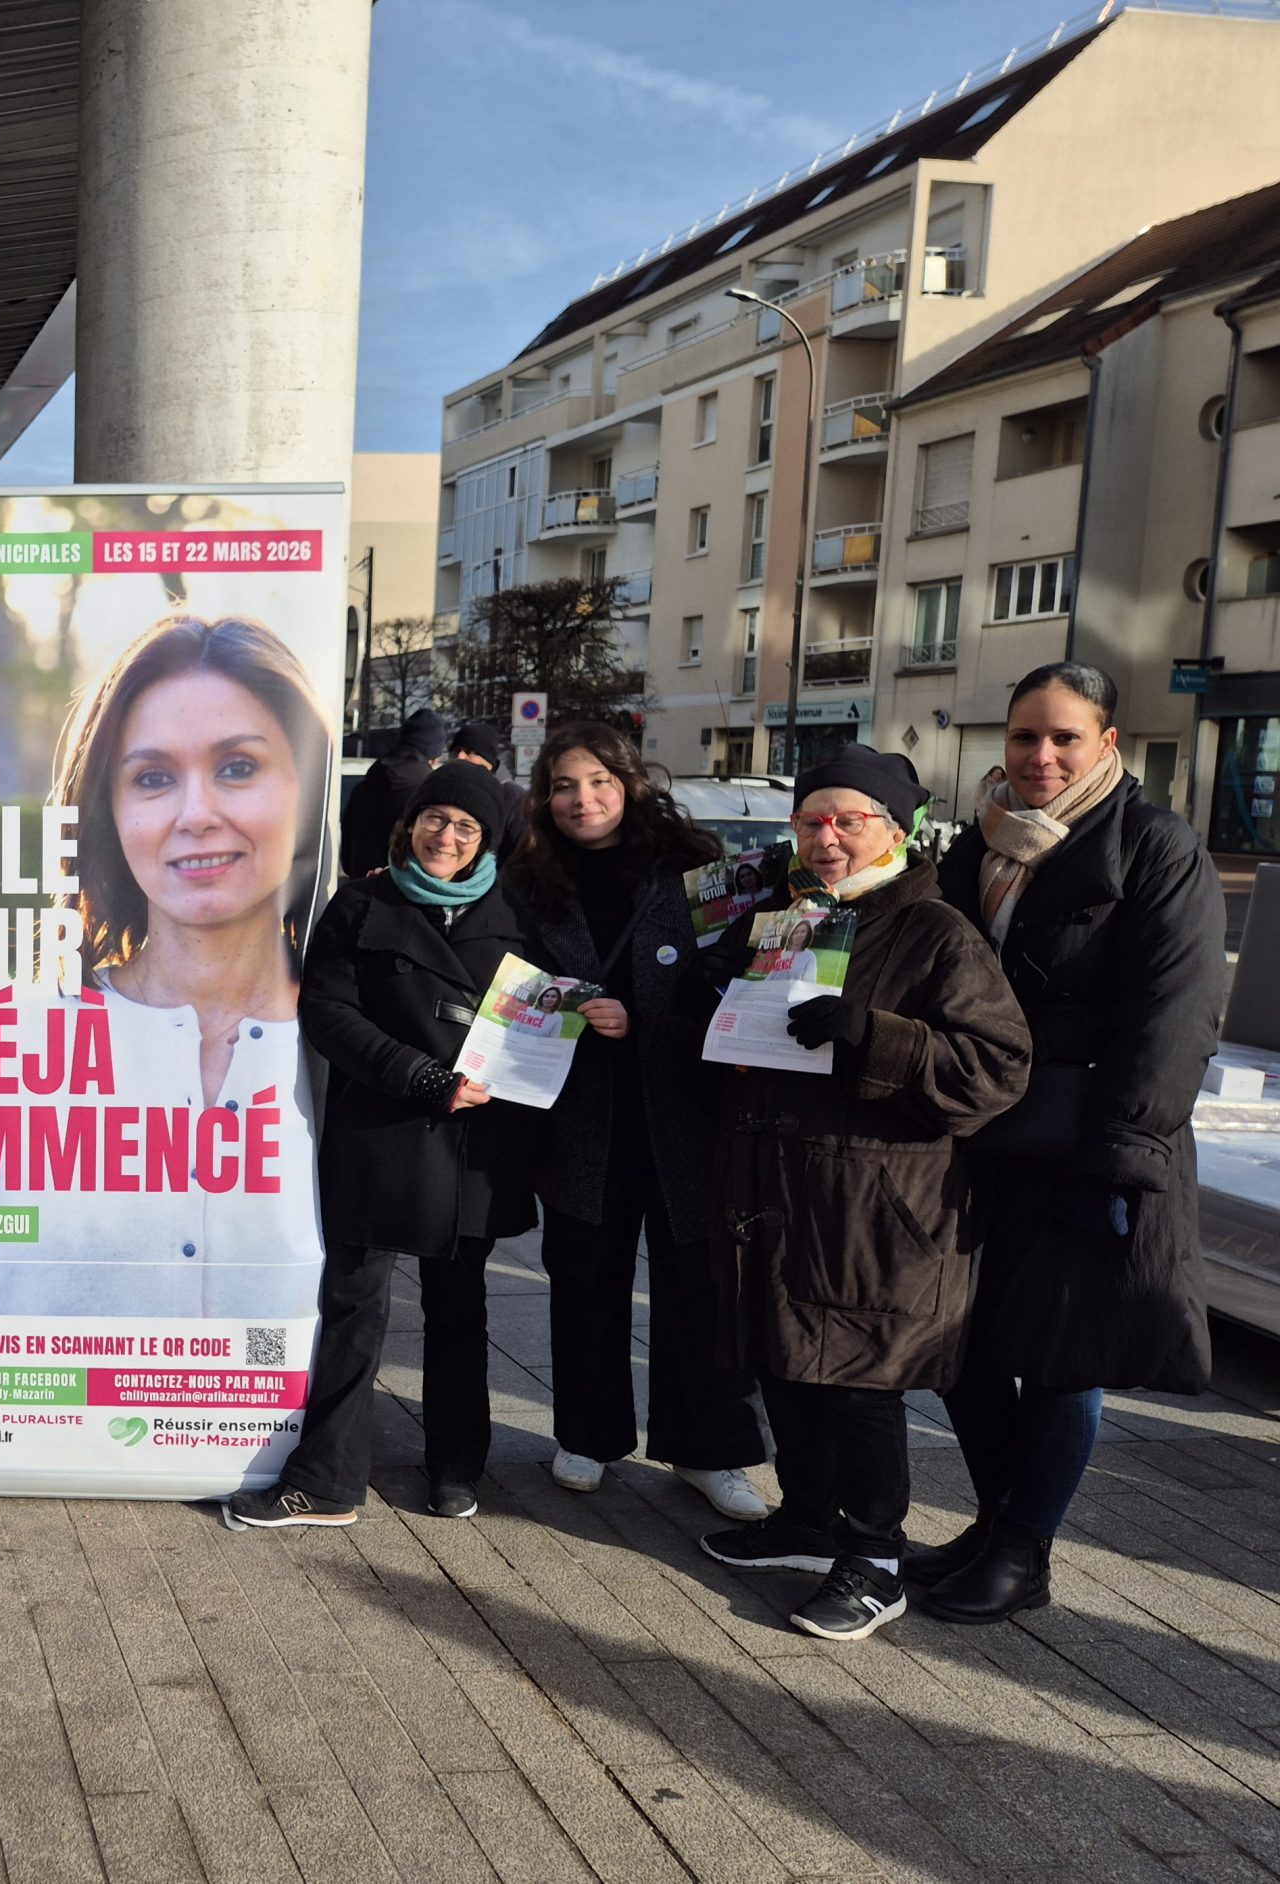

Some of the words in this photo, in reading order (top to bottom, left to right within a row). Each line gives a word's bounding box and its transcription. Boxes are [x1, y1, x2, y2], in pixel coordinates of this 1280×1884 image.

[104, 543, 133, 563] LES
[138, 542, 157, 562] 15
[162, 542, 181, 562] ET
[185, 542, 208, 562] 22
[213, 541, 262, 562] MARS
[267, 541, 312, 562] 2026
[2, 806, 80, 894] LE
[26, 1336, 46, 1354] EN
[51, 1336, 135, 1356] SCANNANT
[140, 1337, 157, 1356] LE
[163, 1337, 184, 1357] QR
[190, 1338, 231, 1357] CODE
[14, 1372, 77, 1387] FACEBOOK
[114, 1374, 221, 1389] CONTACTEZ-NOUS
[225, 1375, 250, 1389] PAR
[254, 1376, 286, 1391] MAIL
[2, 1414, 84, 1425] PLURALISTE
[153, 1418, 214, 1431] Réussir
[219, 1419, 299, 1433] ensemble
[153, 1434, 271, 1449] Chilly-Mazarin
